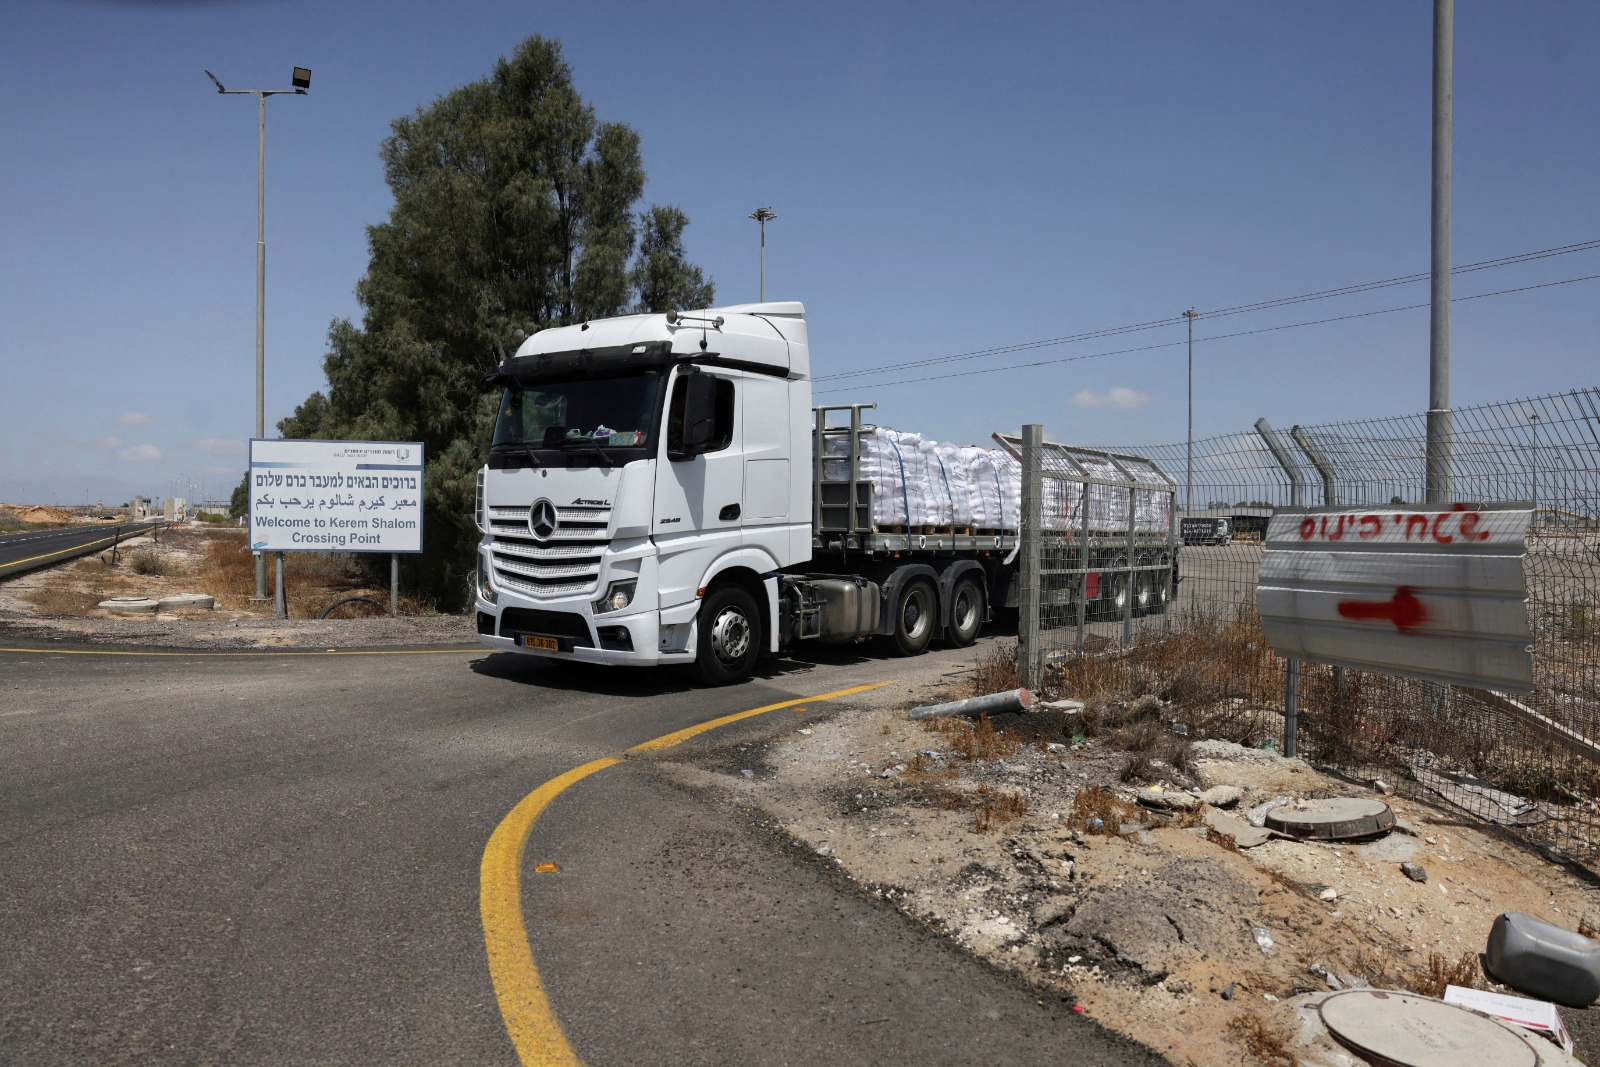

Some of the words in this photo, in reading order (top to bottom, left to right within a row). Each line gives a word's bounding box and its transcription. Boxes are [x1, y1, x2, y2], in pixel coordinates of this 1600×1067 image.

[256, 471, 283, 487] שלום
[286, 475, 307, 488] כרם
[309, 472, 344, 489] למעבר
[346, 475, 379, 489] הבאים
[382, 476, 417, 490] ברוכים
[255, 494, 275, 511] بكم
[279, 497, 315, 511] يرحب
[318, 493, 355, 512] شالوم
[358, 495, 386, 512] كيرم
[390, 499, 417, 511] معبر
[255, 516, 311, 528] Welcome
[314, 518, 328, 528] to
[330, 517, 368, 529] Kerem
[372, 518, 417, 529] Shalom
[1300, 515, 1384, 541] כינוס
[292, 532, 346, 546] Crossing
[350, 533, 381, 544] Point
